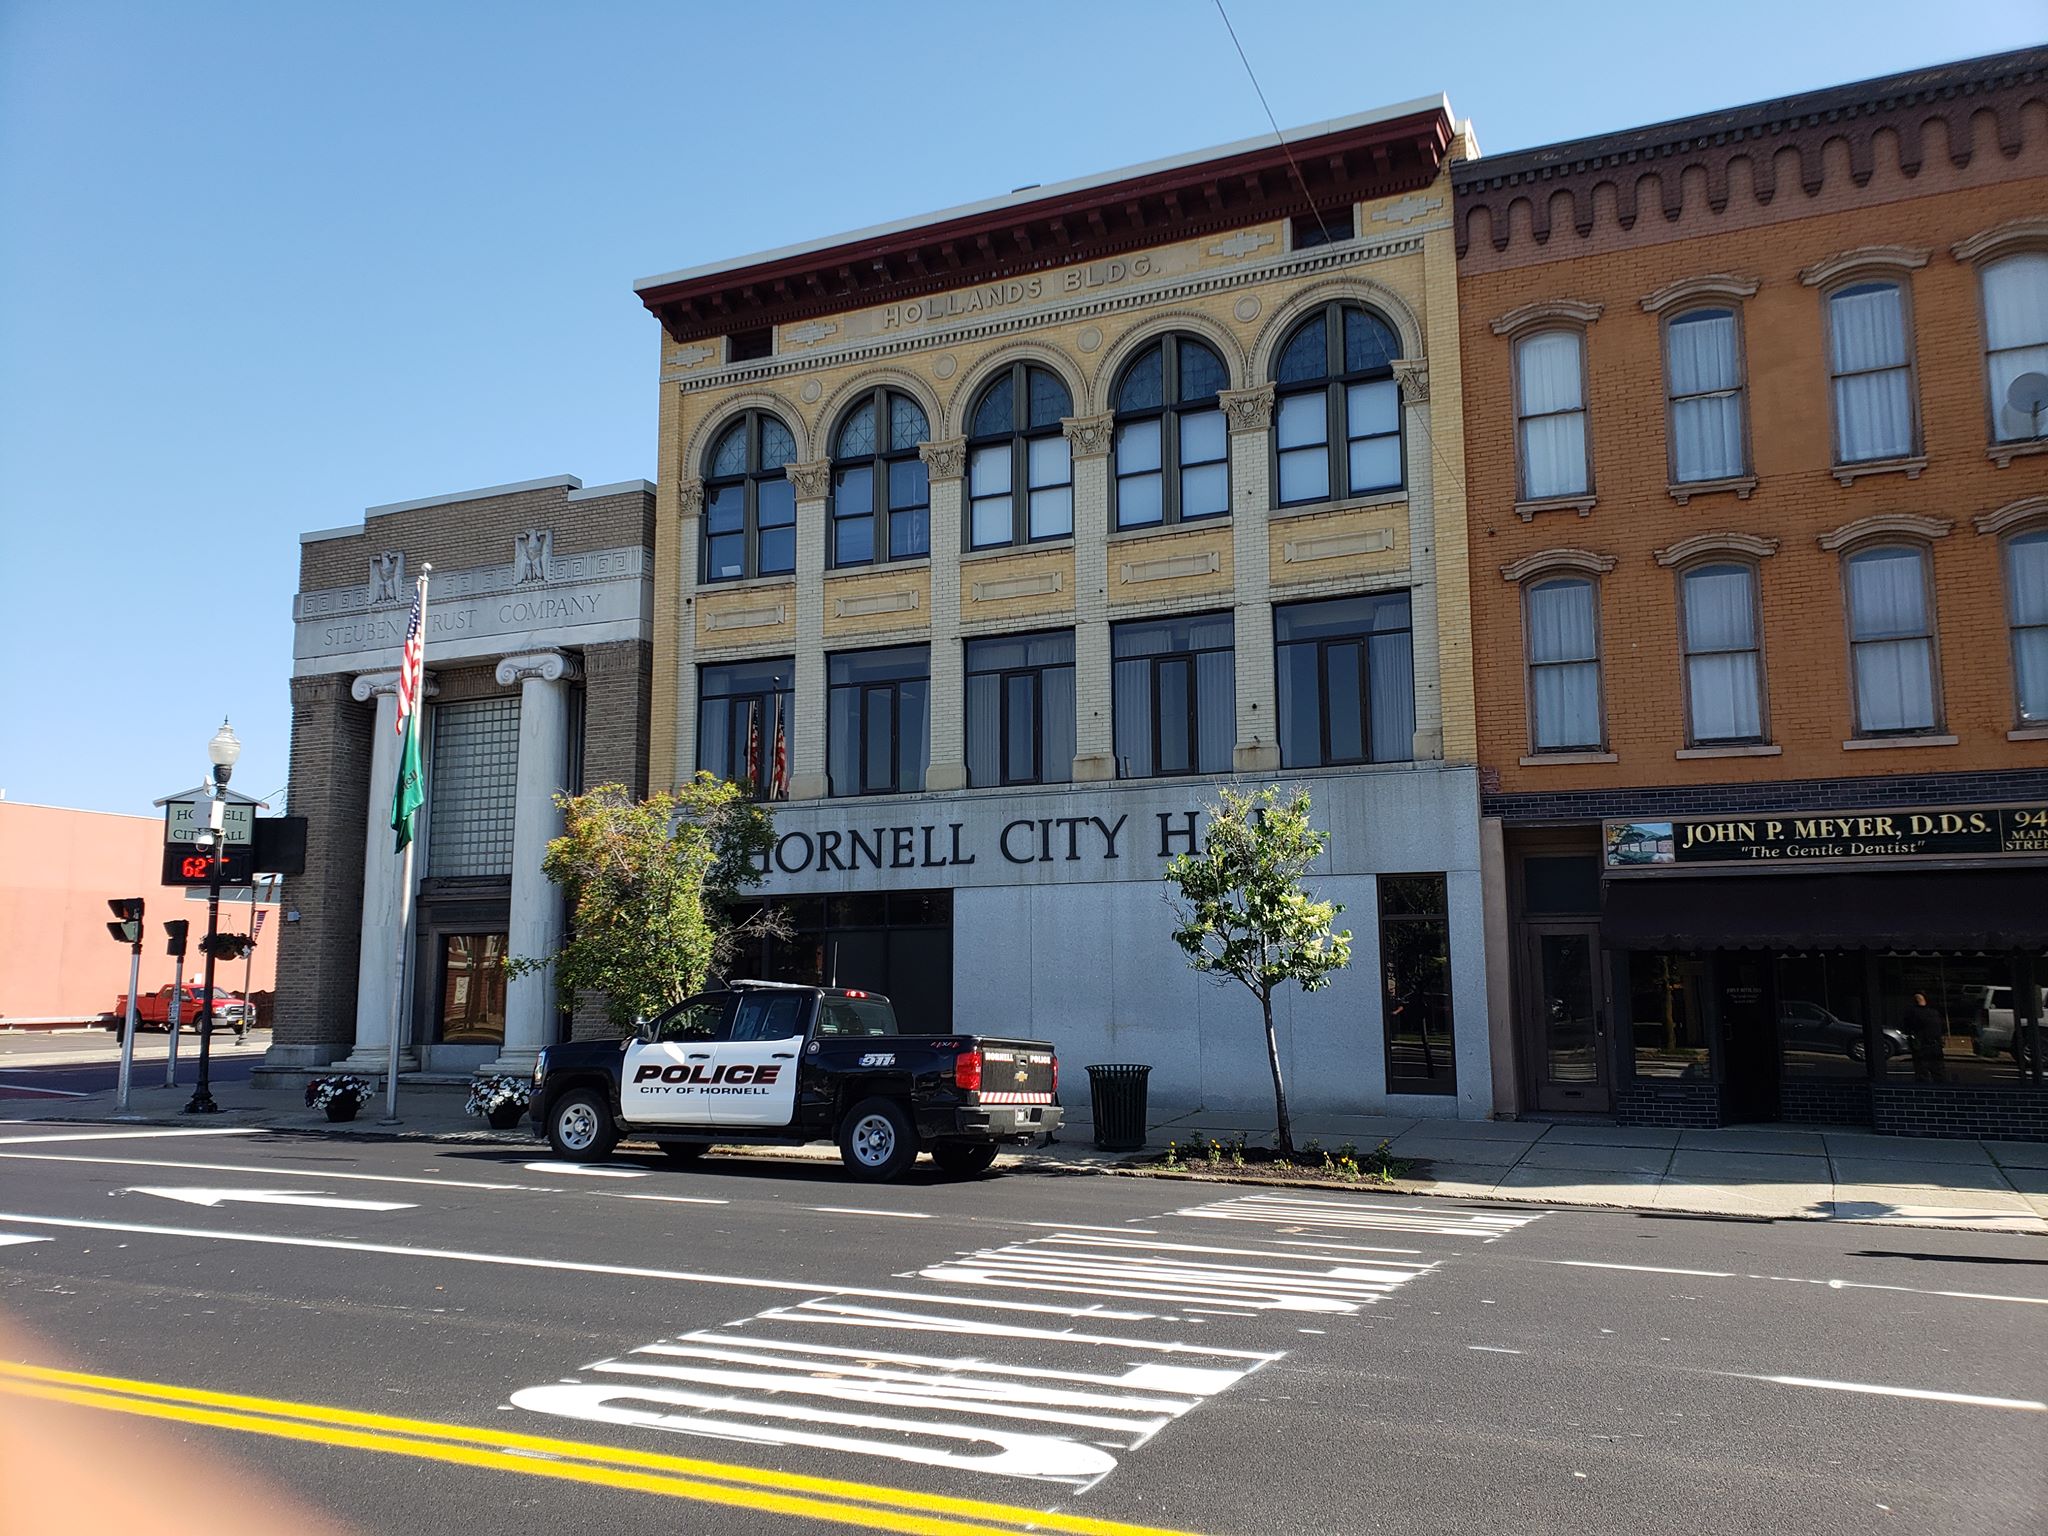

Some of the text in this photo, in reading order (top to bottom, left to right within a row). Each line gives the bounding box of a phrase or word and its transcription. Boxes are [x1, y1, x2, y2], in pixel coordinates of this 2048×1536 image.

[883, 256, 1161, 329] HOLLANDS BLDG.
[324, 620, 402, 646] STEUBEN
[499, 594, 601, 623] COMPANY
[1000, 814, 1128, 864] CITY
[1682, 813, 1992, 849] JOHN P. MEYER, D.D.S.
[1741, 840, 1926, 858] "The Gentle Dentist"
[861, 1056, 893, 1067] 911
[1029, 1055, 1051, 1065] POLICE
[633, 1064, 782, 1085] POLICE
[640, 1086, 671, 1094] CITY
[700, 1087, 769, 1095] HORNELL
